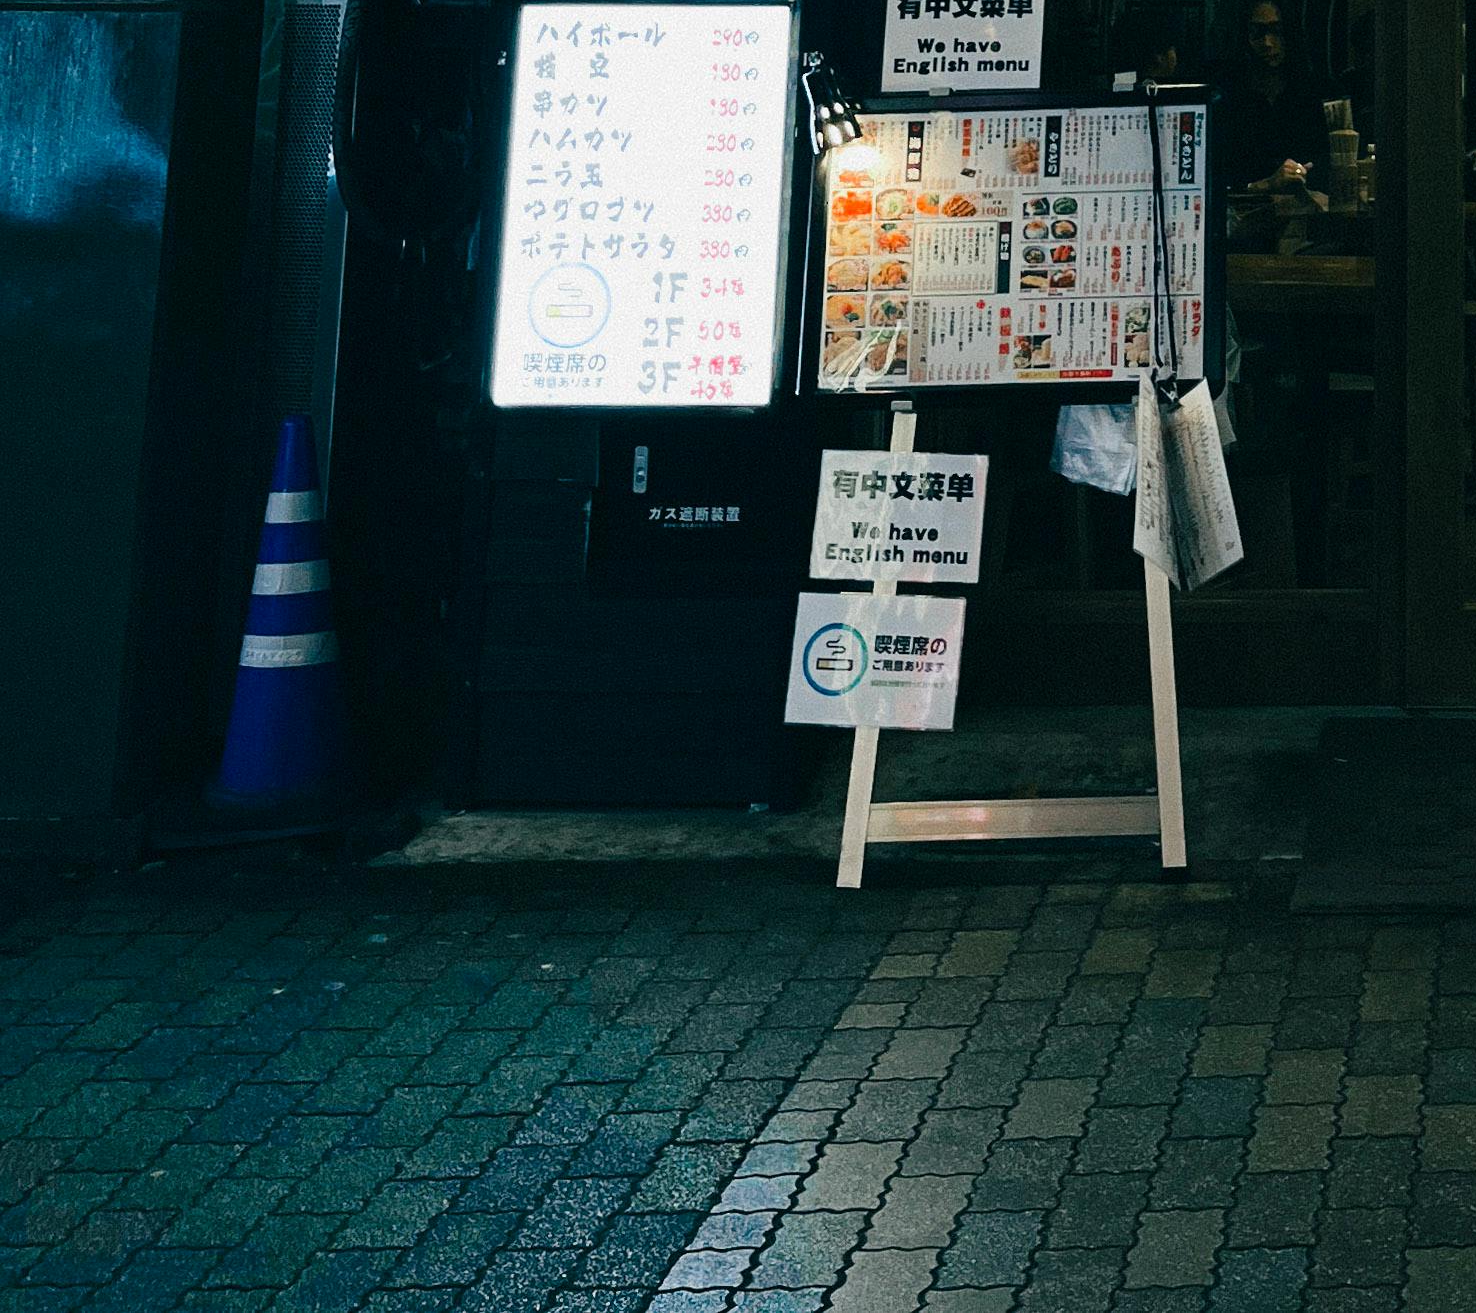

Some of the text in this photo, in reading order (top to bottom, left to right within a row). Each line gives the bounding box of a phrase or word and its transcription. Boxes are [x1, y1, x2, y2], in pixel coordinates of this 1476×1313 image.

[536, 20, 667, 48] ハイボール
[917, 37, 1002, 54] We have
[892, 57, 1030, 76] English menu
[532, 89, 609, 119] 串カツ
[528, 127, 633, 153] ハムカツ
[525, 160, 604, 190] ニラ玉
[651, 271, 688, 304] 1F
[641, 316, 685, 348] 2F
[522, 352, 607, 374] 喫煙席の
[637, 360, 682, 395] 3F
[832, 470, 976, 503] 有中文菜单
[850, 520, 940, 542] We have
[824, 543, 969, 565] English menu
[873, 634, 948, 657] 喫煙席の
